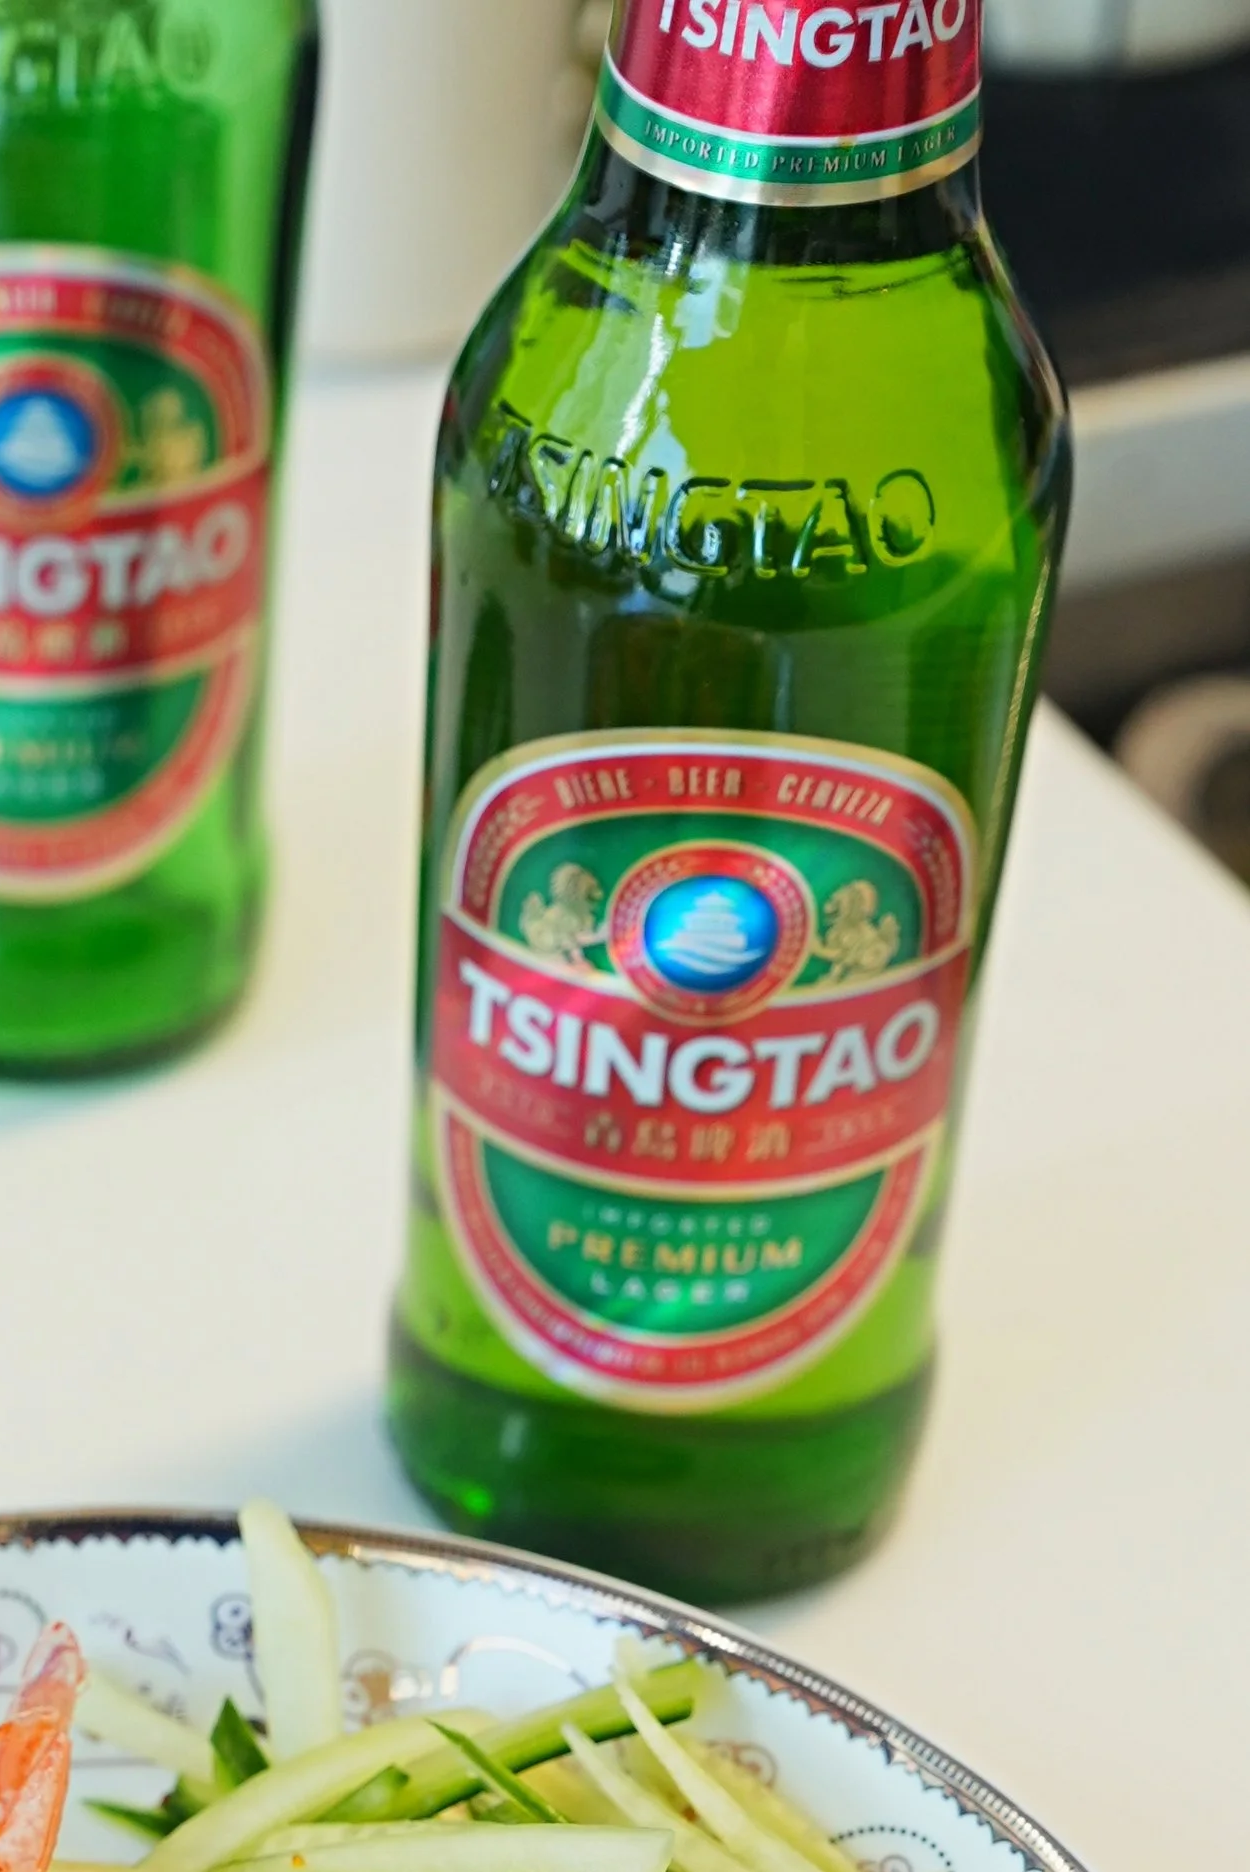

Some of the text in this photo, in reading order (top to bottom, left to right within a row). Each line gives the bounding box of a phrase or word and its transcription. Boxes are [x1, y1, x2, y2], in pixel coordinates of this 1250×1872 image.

[643, 119, 956, 173] IMPORTED PREMIUM LAGER
[486, 399, 937, 578] TSINGTAO
[667, 765, 743, 798] BEER
[776, 771, 895, 827] CERVEZA
[459, 958, 941, 1114] TSINGTAO
[548, 1219, 804, 1276] PREMIUM
